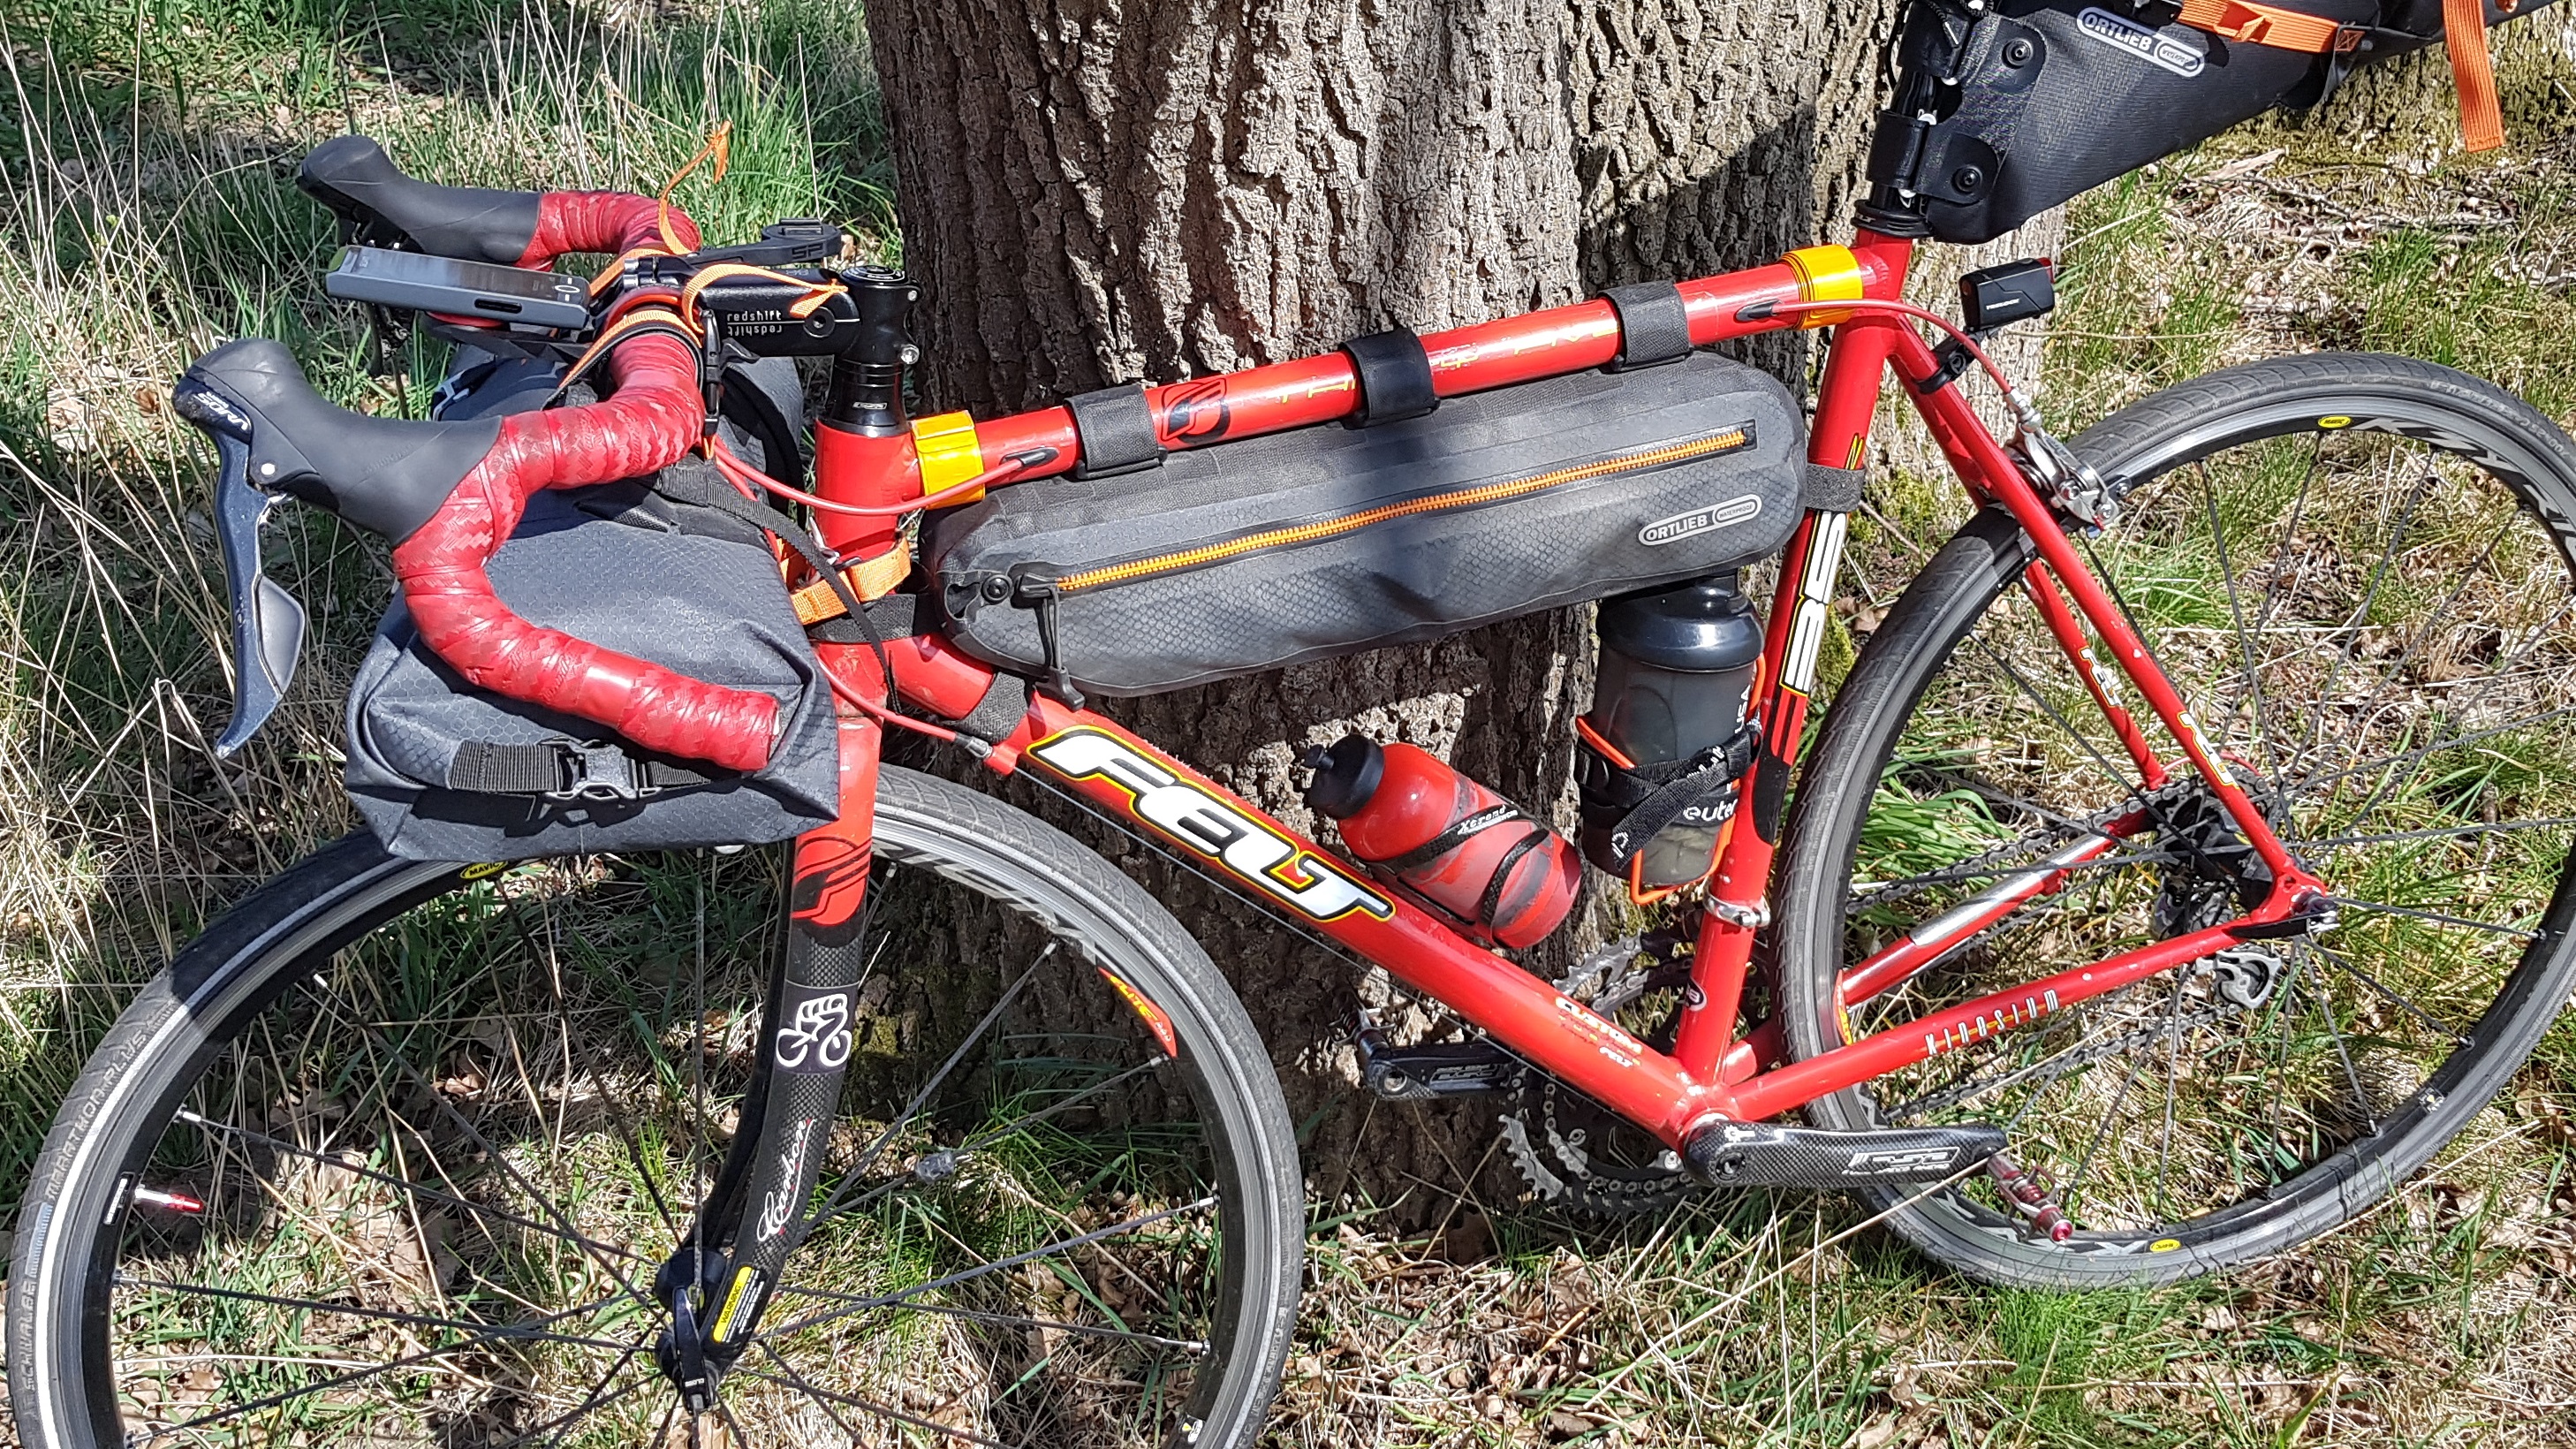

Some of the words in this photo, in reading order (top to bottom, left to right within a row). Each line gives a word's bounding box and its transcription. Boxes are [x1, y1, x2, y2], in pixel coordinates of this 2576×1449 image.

[2084, 13, 2153, 51] ORTLIEB
[727, 309, 783, 322] redshift
[727, 324, 784, 337] redshift
[1645, 514, 1708, 541] ORTLIEB
[1028, 732, 1391, 919] FELT
[1556, 997, 1642, 1054] CUSTOM
[45, 1086, 106, 1201] MARATHON
[756, 1119, 816, 1242] Carbon
[19, 1279, 38, 1392] SCHWALBE
